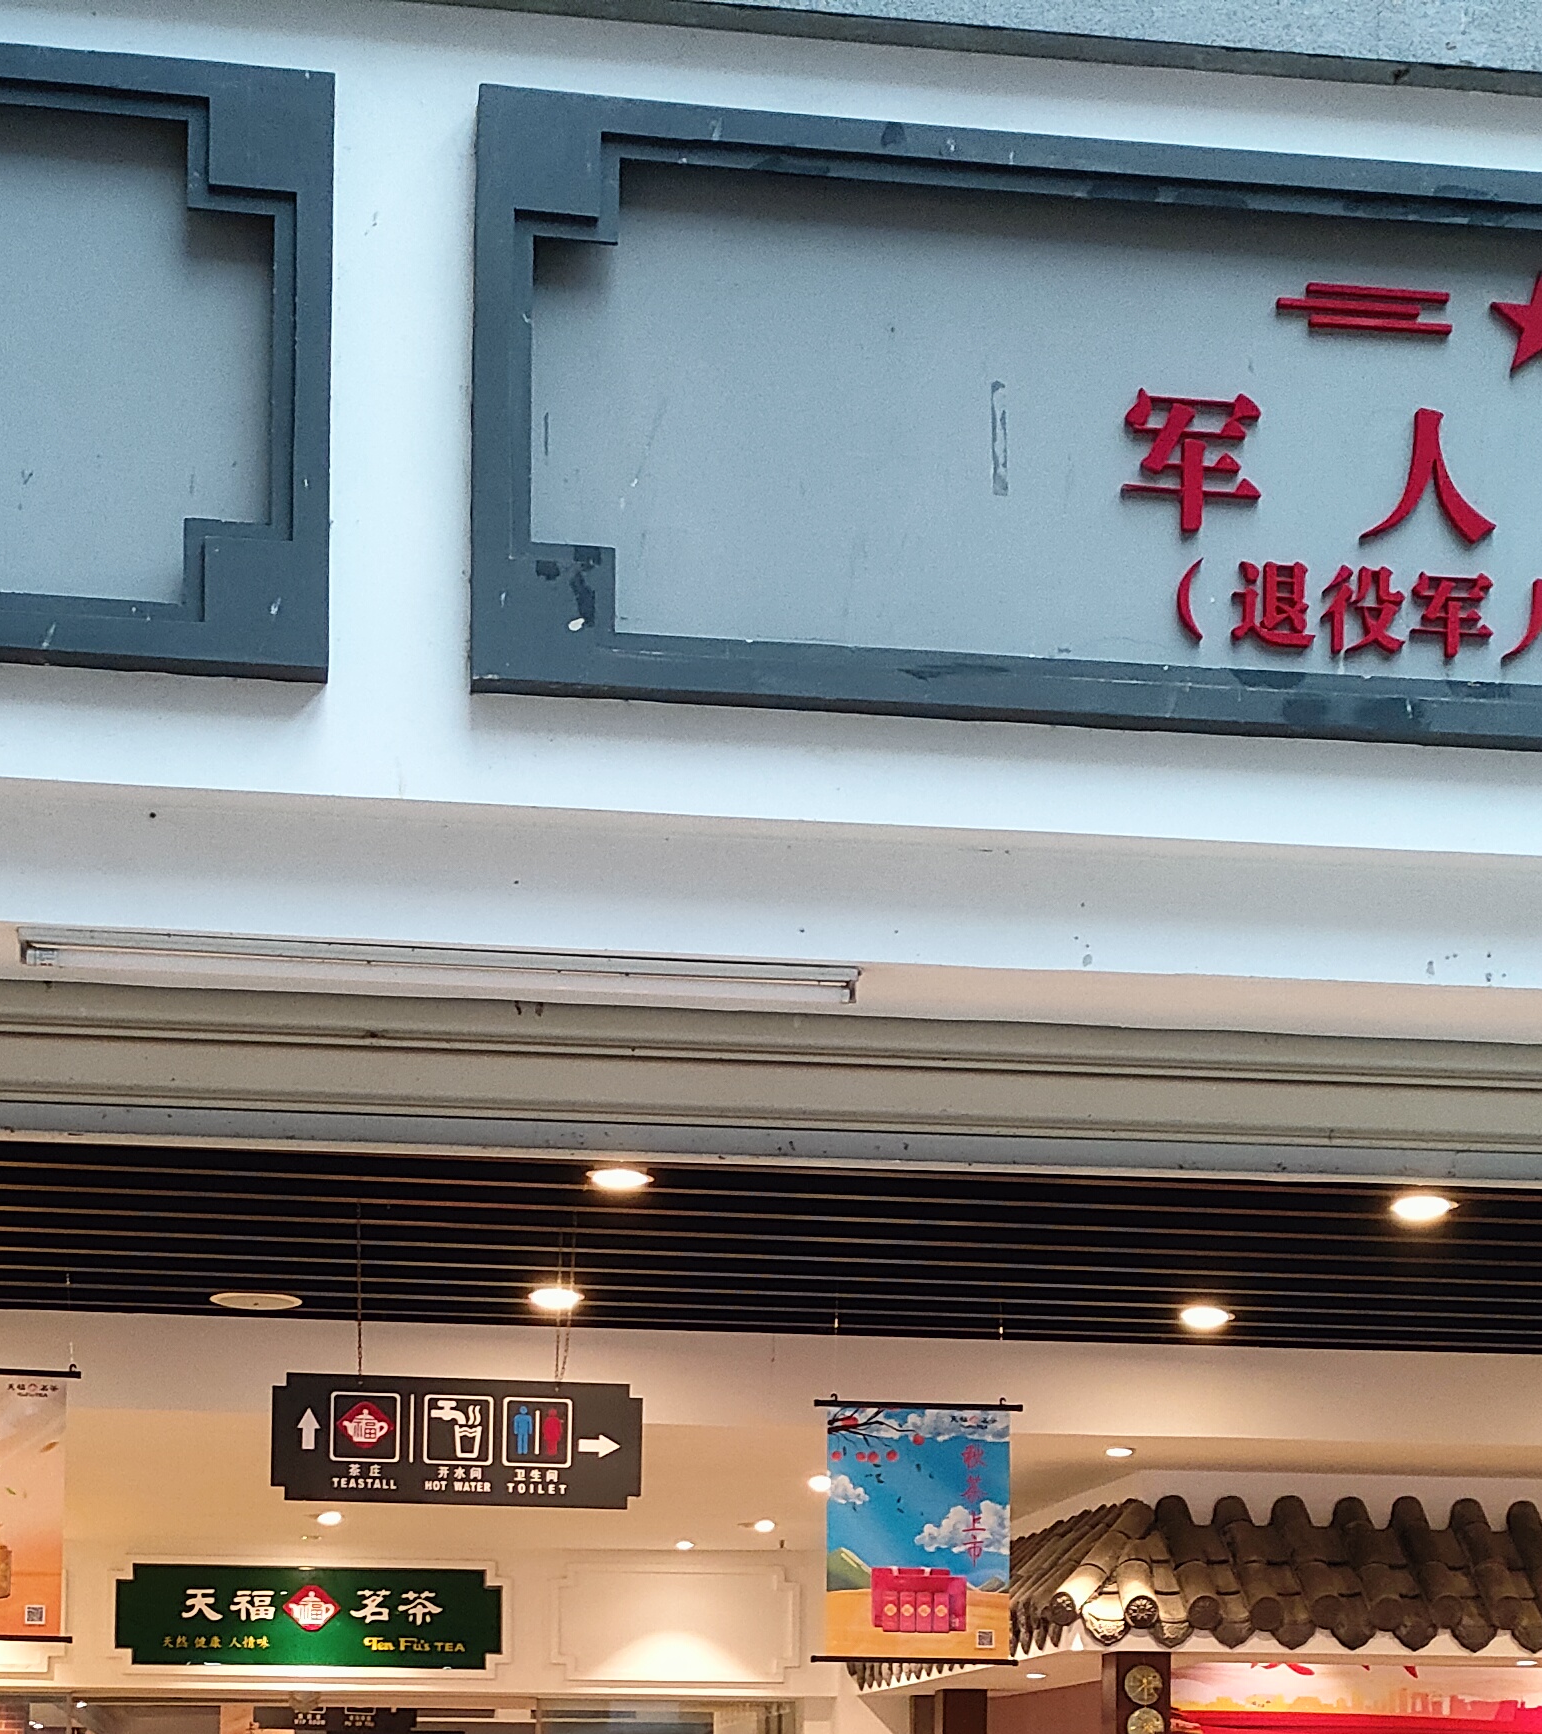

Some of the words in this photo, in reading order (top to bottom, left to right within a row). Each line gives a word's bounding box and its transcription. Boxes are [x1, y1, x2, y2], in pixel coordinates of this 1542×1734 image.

[513, 1468, 559, 1483] 卫生间
[332, 1477, 398, 1490] TEASTALL
[424, 1480, 448, 1492] HOT
[454, 1481, 492, 1494] WATER
[507, 1483, 568, 1495] TOILET
[181, 1588, 277, 1621] 天福
[349, 1588, 445, 1626] 茗茶
[434, 1641, 466, 1653] TEA
